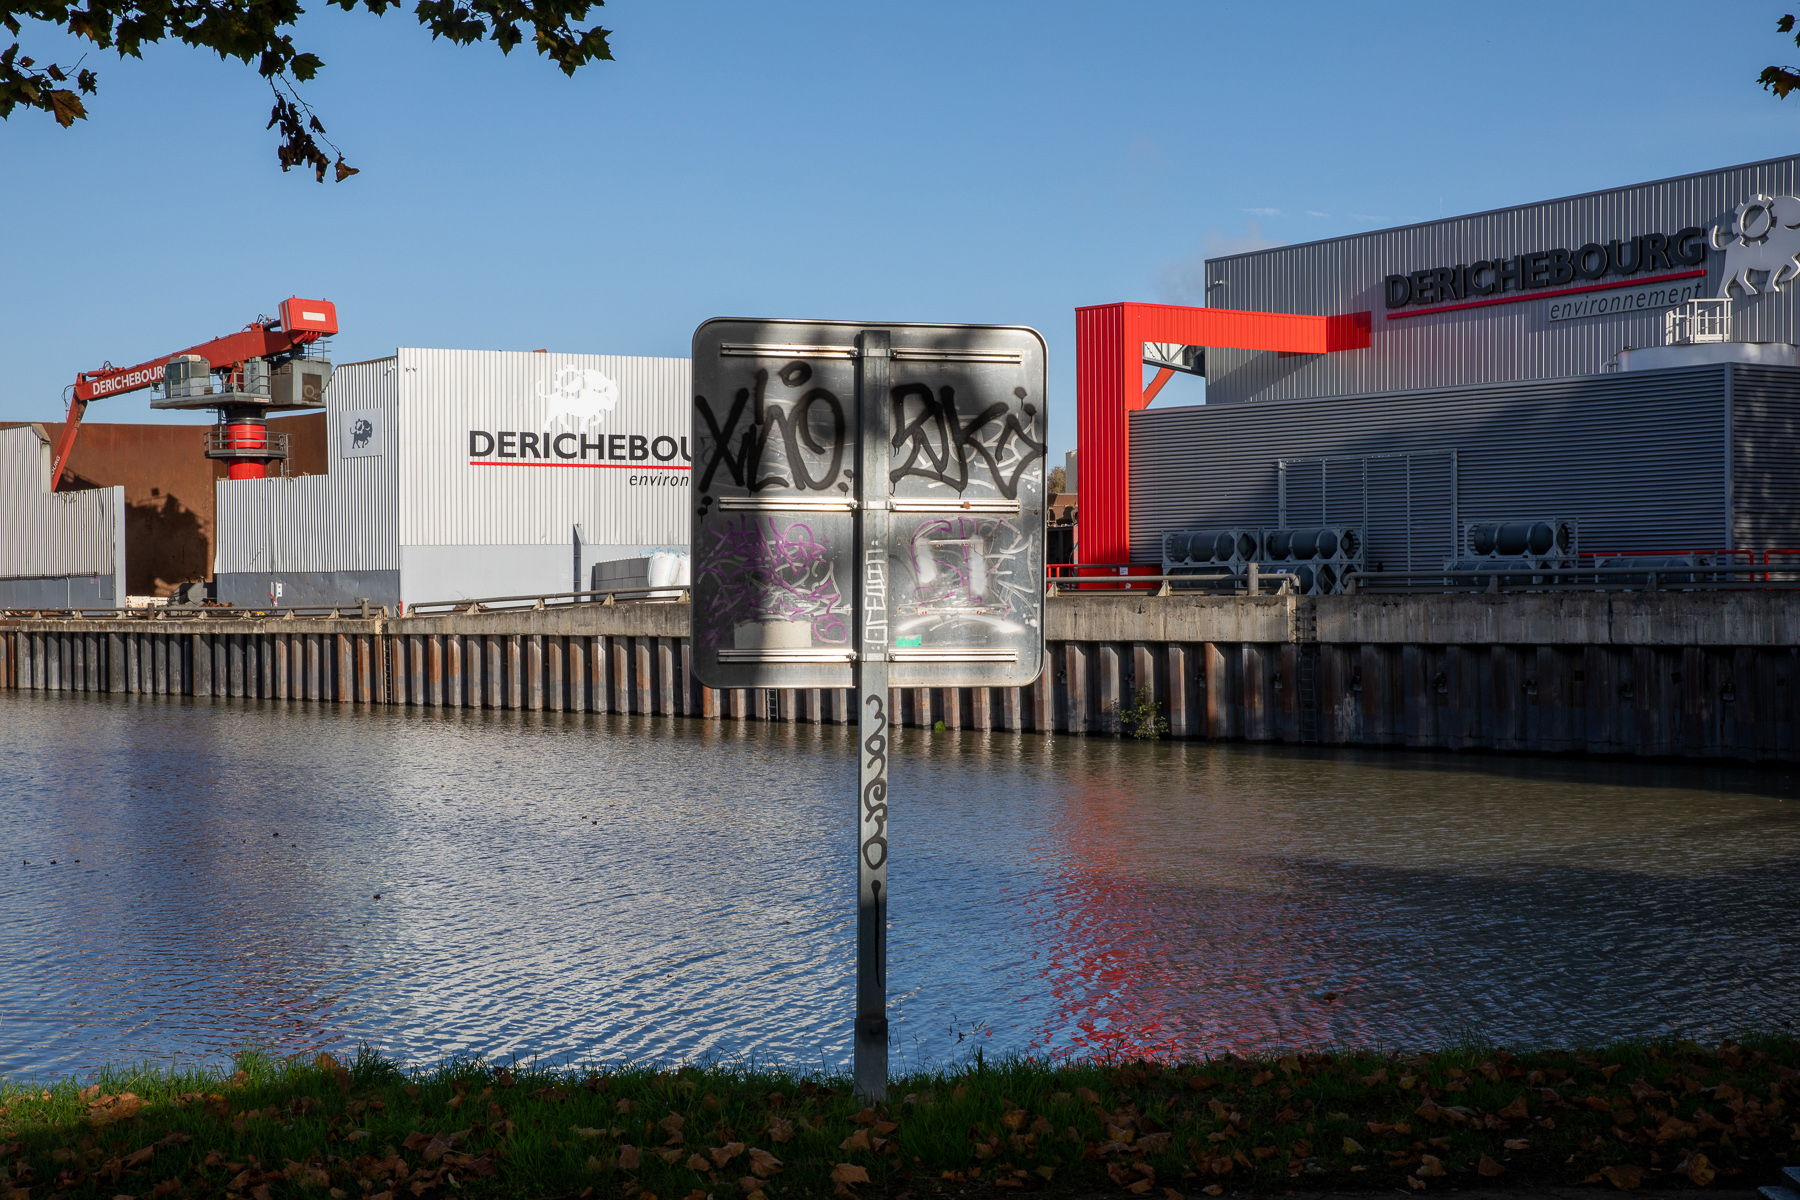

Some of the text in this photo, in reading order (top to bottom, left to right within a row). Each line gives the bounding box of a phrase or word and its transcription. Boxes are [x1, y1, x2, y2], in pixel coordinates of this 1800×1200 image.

[1385, 226, 1705, 309] DERICHEBOURG
[1550, 282, 1702, 320] environnement
[629, 472, 689, 487] environ
